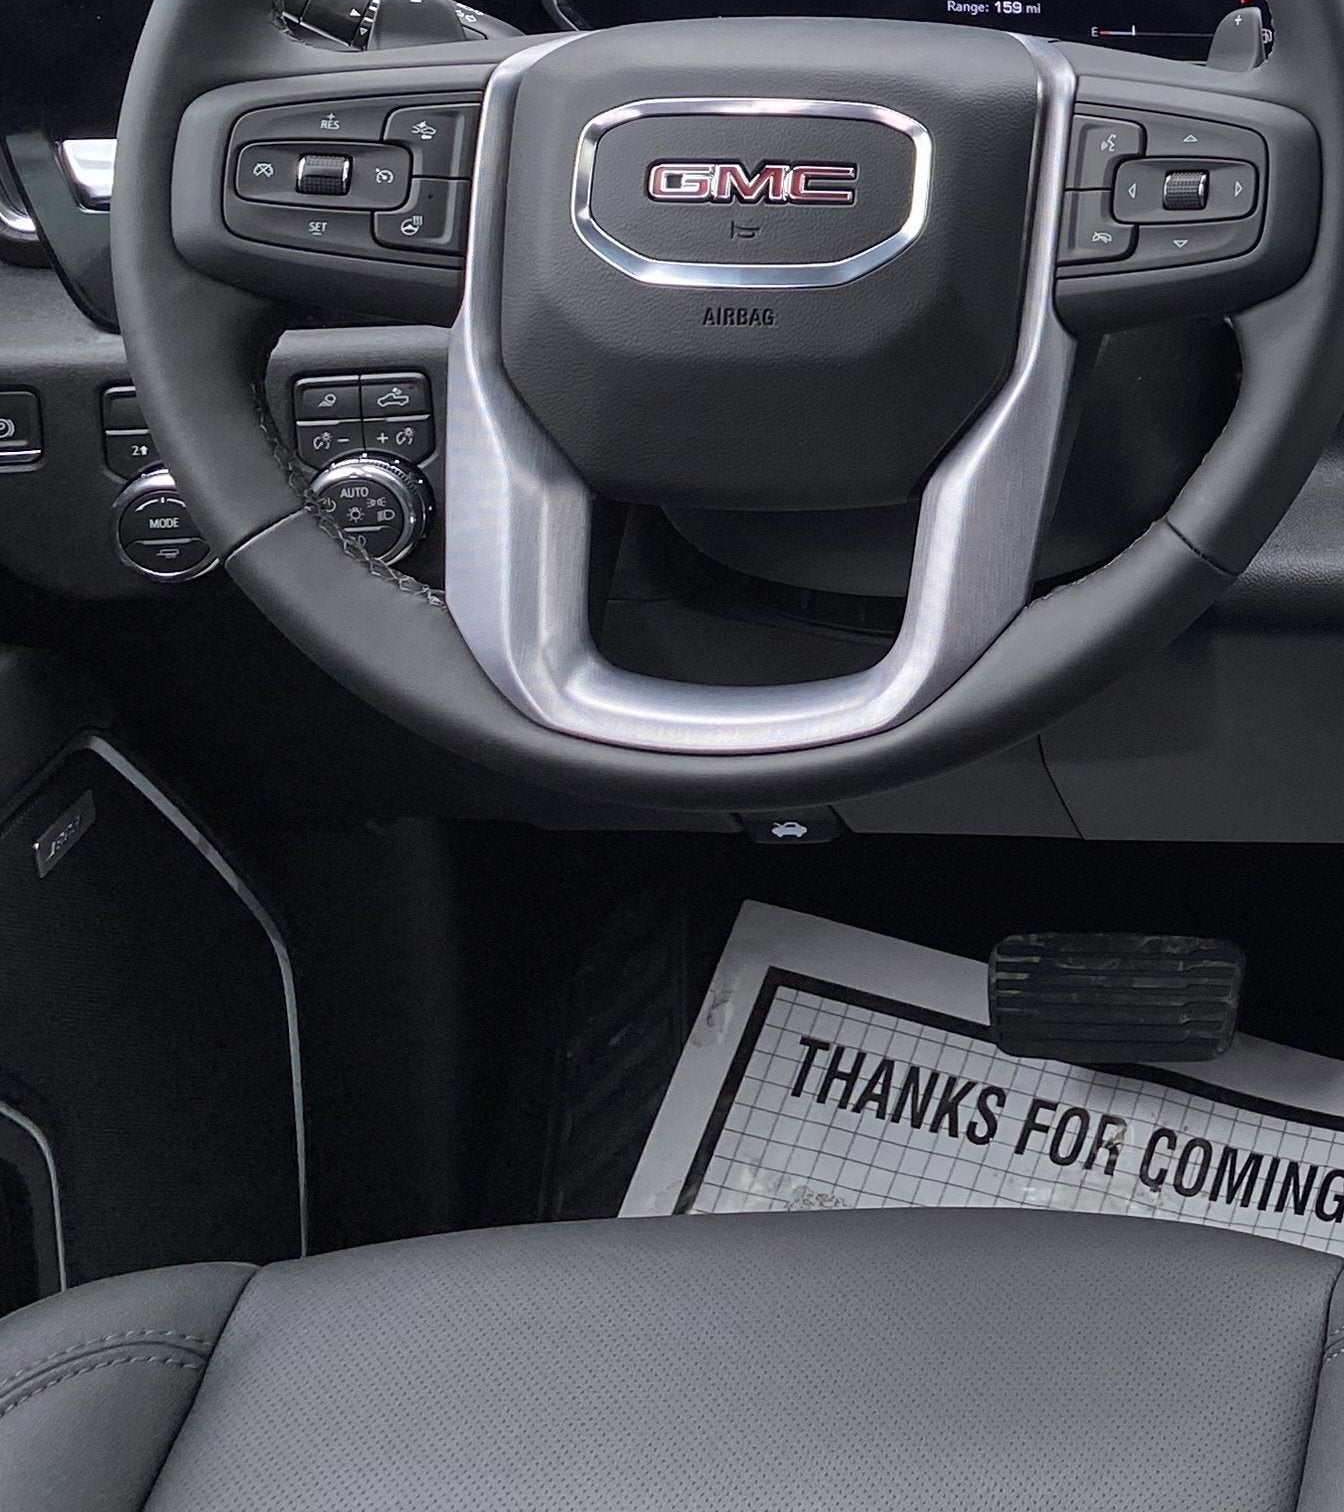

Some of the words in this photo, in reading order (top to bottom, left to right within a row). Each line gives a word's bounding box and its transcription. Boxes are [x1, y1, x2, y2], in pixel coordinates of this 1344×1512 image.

[947, 0, 990, 16] Range:
[994, 0, 1022, 14] 159
[1026, 3, 1041, 14] mi
[320, 120, 340, 130] RES
[648, 163, 857, 202] GMC
[309, 222, 328, 232] SET
[702, 306, 775, 326] AIRBAG
[131, 445, 140, 456] 2
[340, 487, 369, 498] AUTO
[149, 517, 181, 529] MODE
[790, 1036, 1006, 1147] THANKS
[1013, 1100, 1127, 1177] FOR
